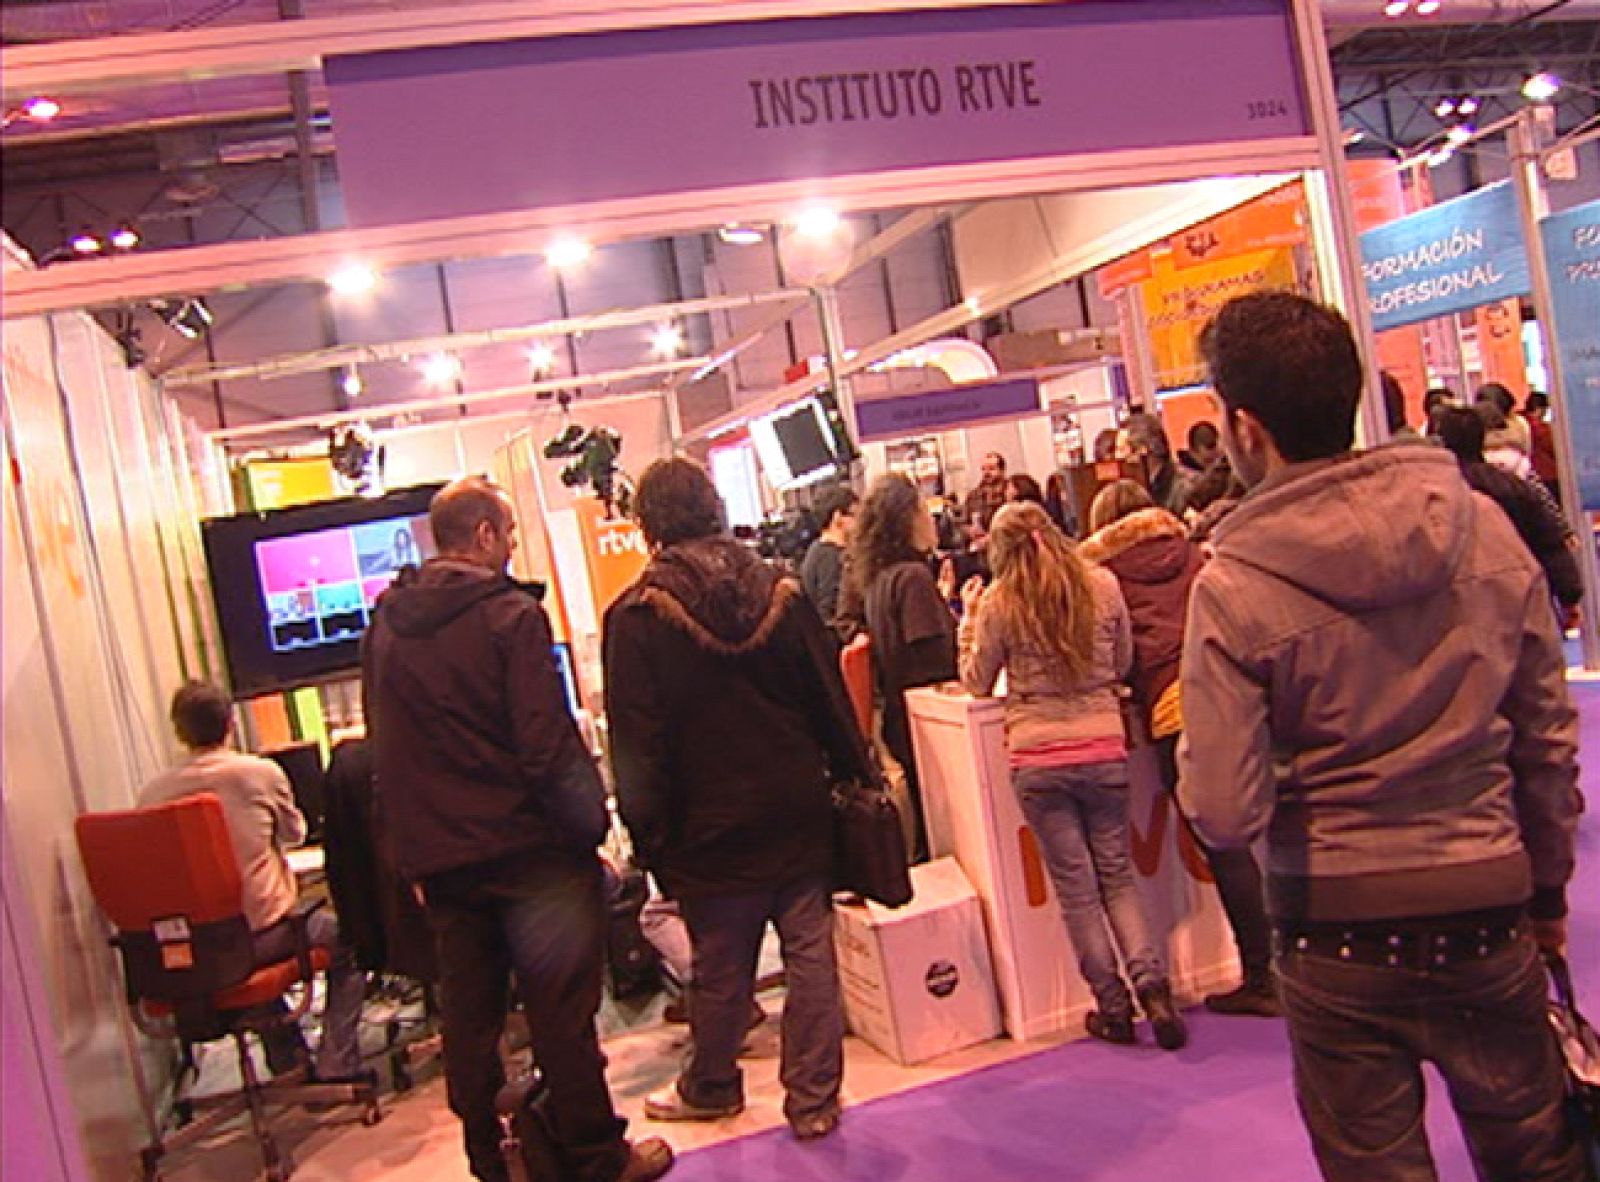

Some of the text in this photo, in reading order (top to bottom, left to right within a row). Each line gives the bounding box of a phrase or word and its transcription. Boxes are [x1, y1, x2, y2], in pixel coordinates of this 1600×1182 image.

[749, 60, 1041, 129] INSTITUTO RTVE
[1248, 100, 1288, 121] 3024
[1361, 225, 1484, 282] FORMACIÓN
